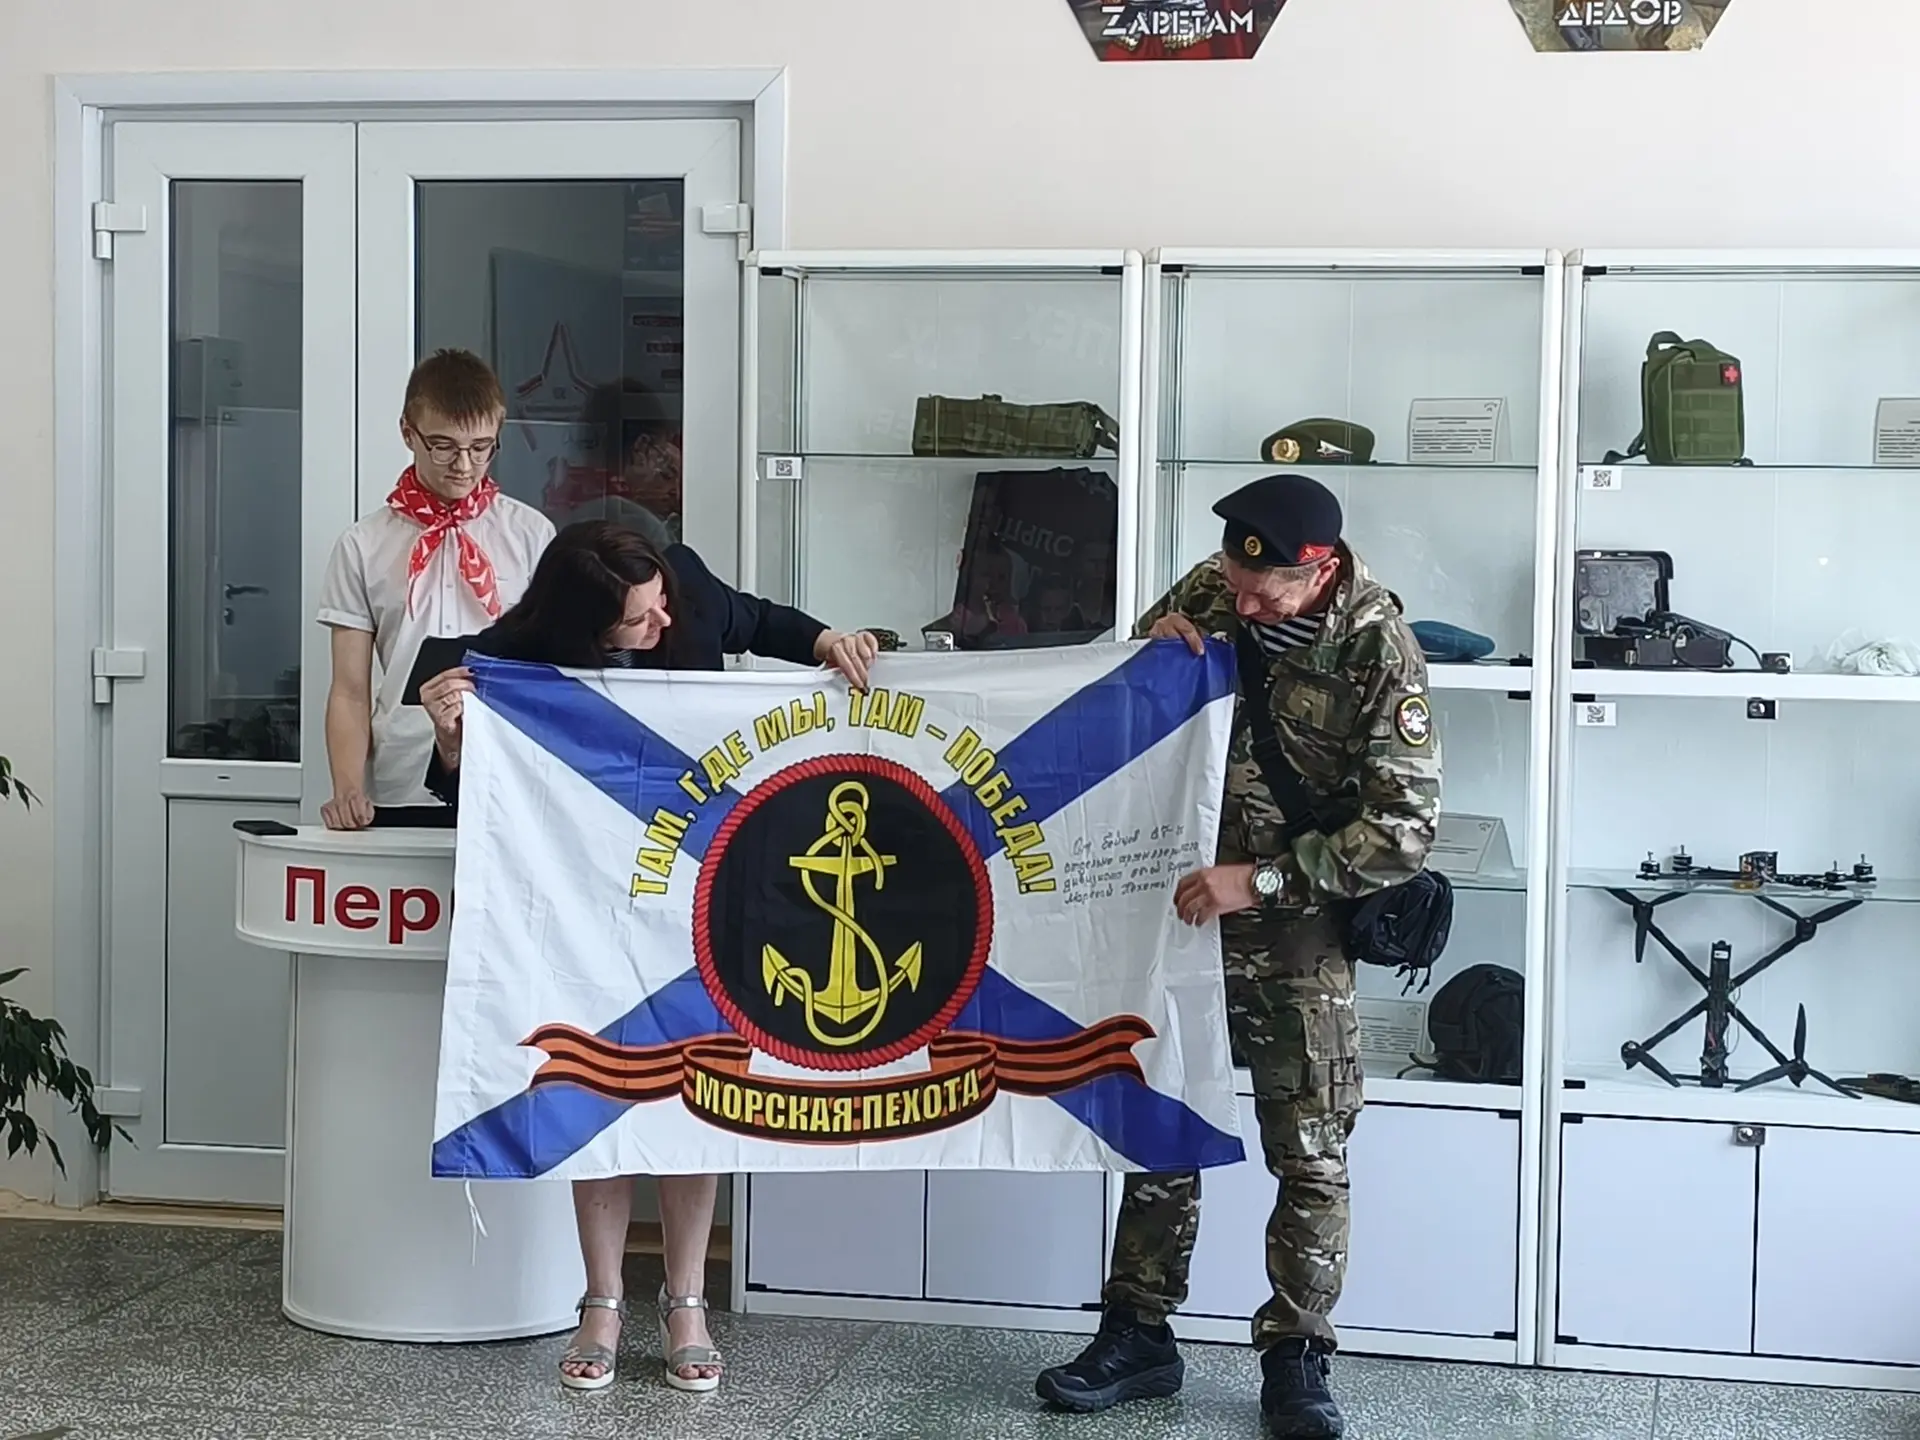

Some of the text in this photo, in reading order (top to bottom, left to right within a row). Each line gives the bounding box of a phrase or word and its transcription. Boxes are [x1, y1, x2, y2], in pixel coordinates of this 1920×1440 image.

[1559, 0, 1682, 26] ДЕДОВ
[630, 806, 698, 897] ТАМ,
[675, 730, 752, 807] ГДЕ
[752, 691, 834, 752] МЫ,
[848, 687, 925, 738] ТАМ
[943, 725, 1058, 895] ПОБЕДА!
[285, 865, 441, 944] Пер
[694, 1069, 981, 1132] МОРСКАЯ ПЕХОТА
